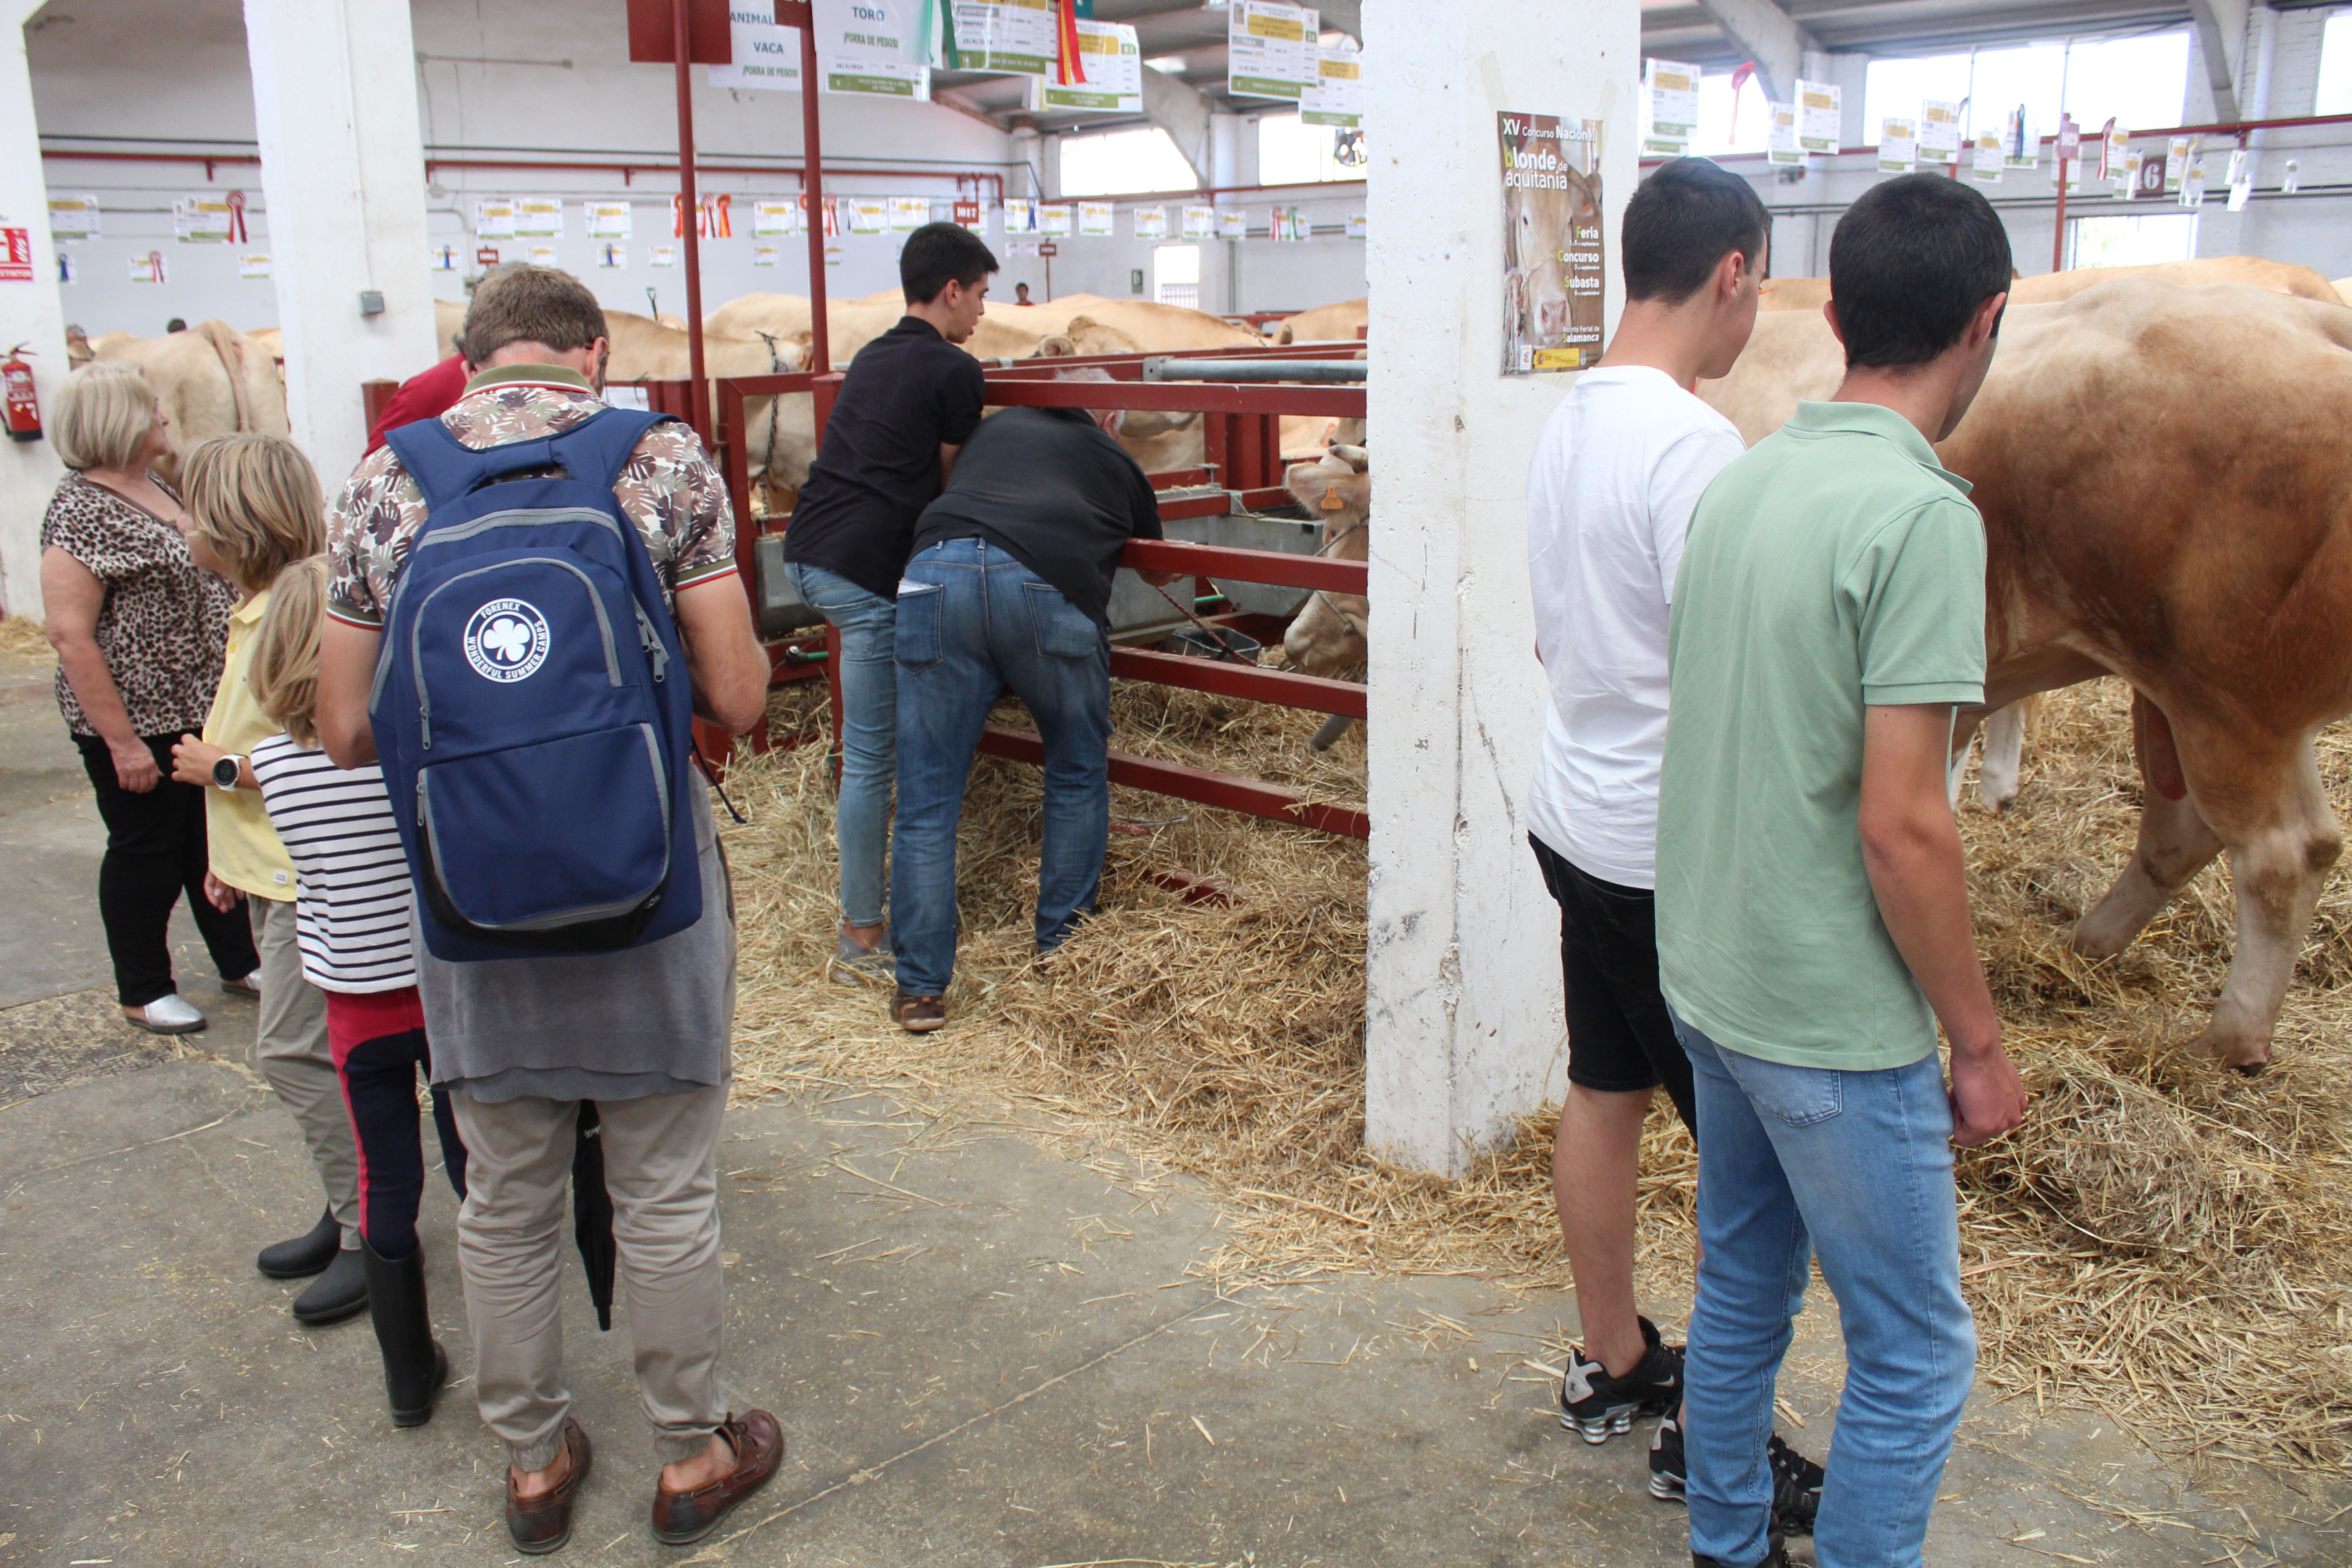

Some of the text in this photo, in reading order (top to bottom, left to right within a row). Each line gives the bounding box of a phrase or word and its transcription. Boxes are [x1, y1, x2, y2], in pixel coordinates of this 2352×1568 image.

[730, 12, 774, 24] ANIMAL
[851, 6, 884, 21] TORO
[867, 35, 875, 45] DE
[754, 41, 783, 54] VACA
[766, 68, 775, 76] DE
[1502, 118, 1521, 136] XV
[1522, 126, 1554, 139] Concurso
[1504, 147, 1568, 172] blonde de
[1506, 170, 1568, 192] aquitania
[2144, 163, 2159, 190] 6
[957, 206, 976, 218] 1017
[1576, 225, 1599, 239] Feria
[1558, 249, 1599, 263] Concurso
[1564, 275, 1599, 289] Subasta
[1563, 333, 1600, 343] Salamanca
[480, 602, 521, 619] FORENEX
[467, 620, 546, 679] WONDERFUL SUMMER CAMPS
